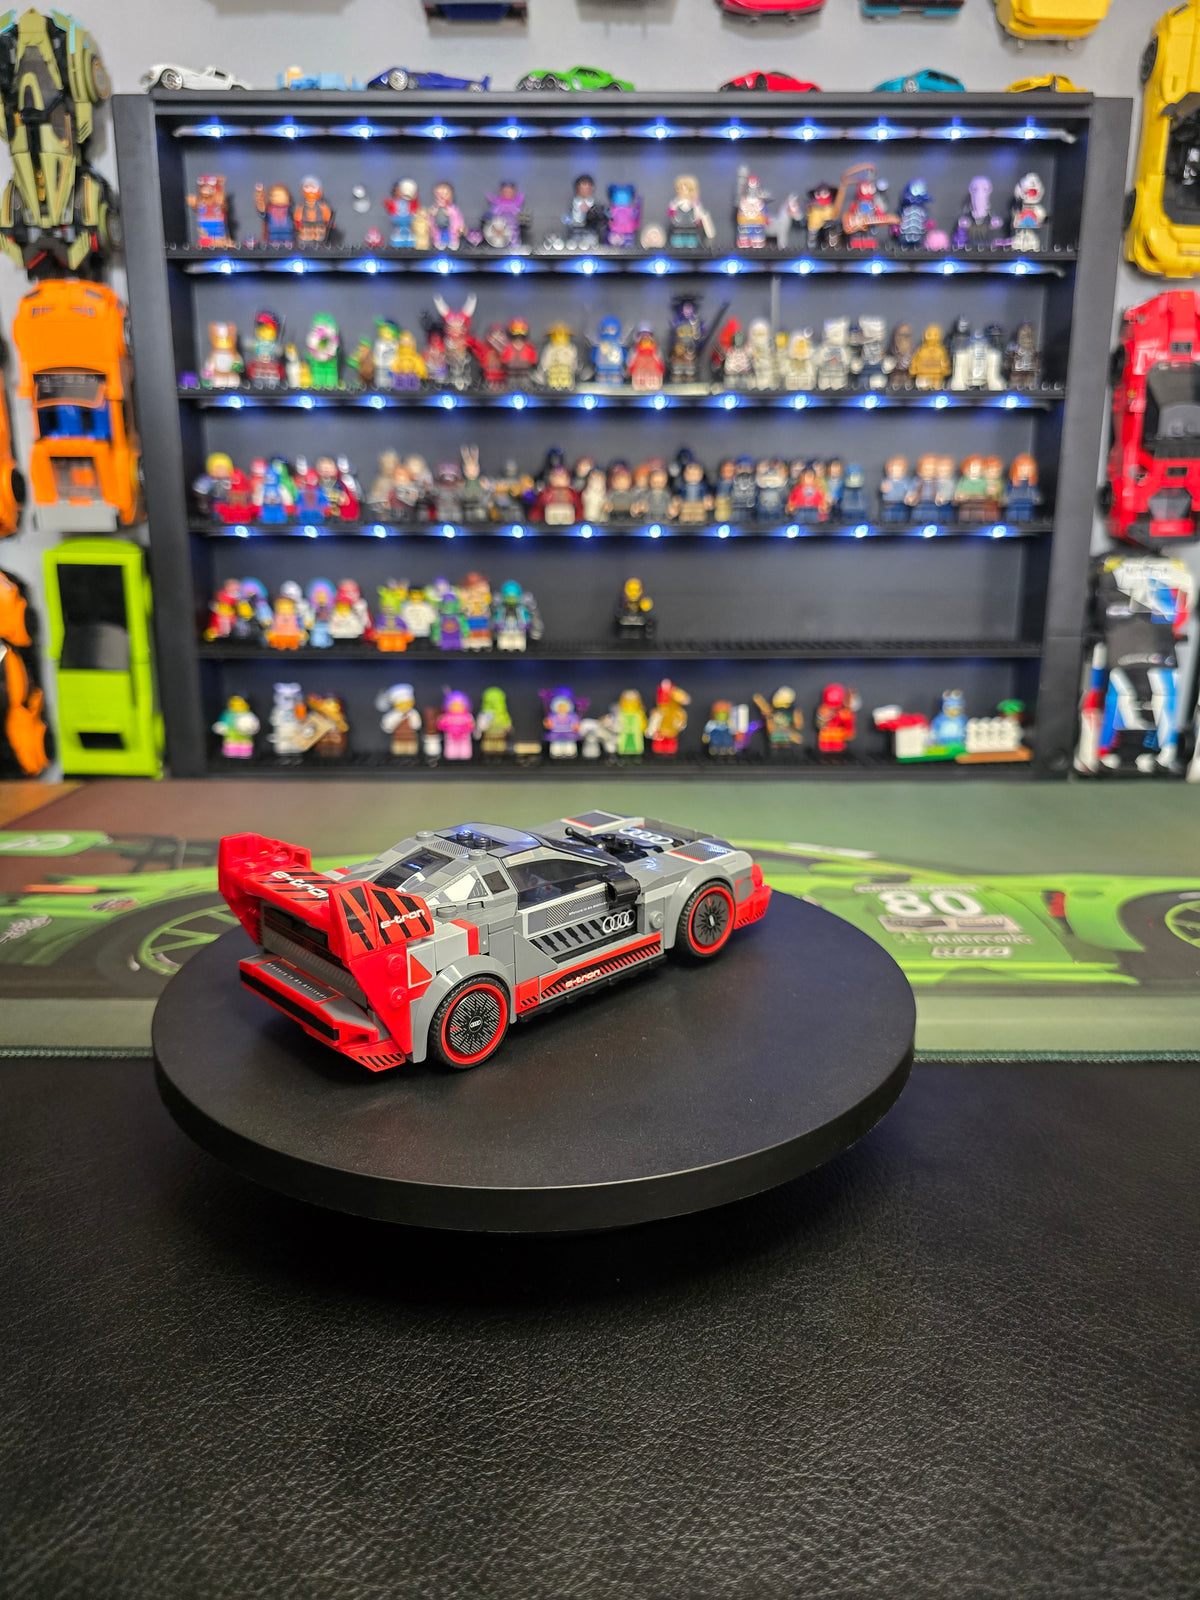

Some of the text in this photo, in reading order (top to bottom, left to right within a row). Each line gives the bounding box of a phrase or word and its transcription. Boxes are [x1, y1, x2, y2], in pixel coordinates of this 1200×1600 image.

[878, 889, 983, 918] 80
[381, 909, 425, 929] e-tron
[565, 969, 600, 988] e-tron
